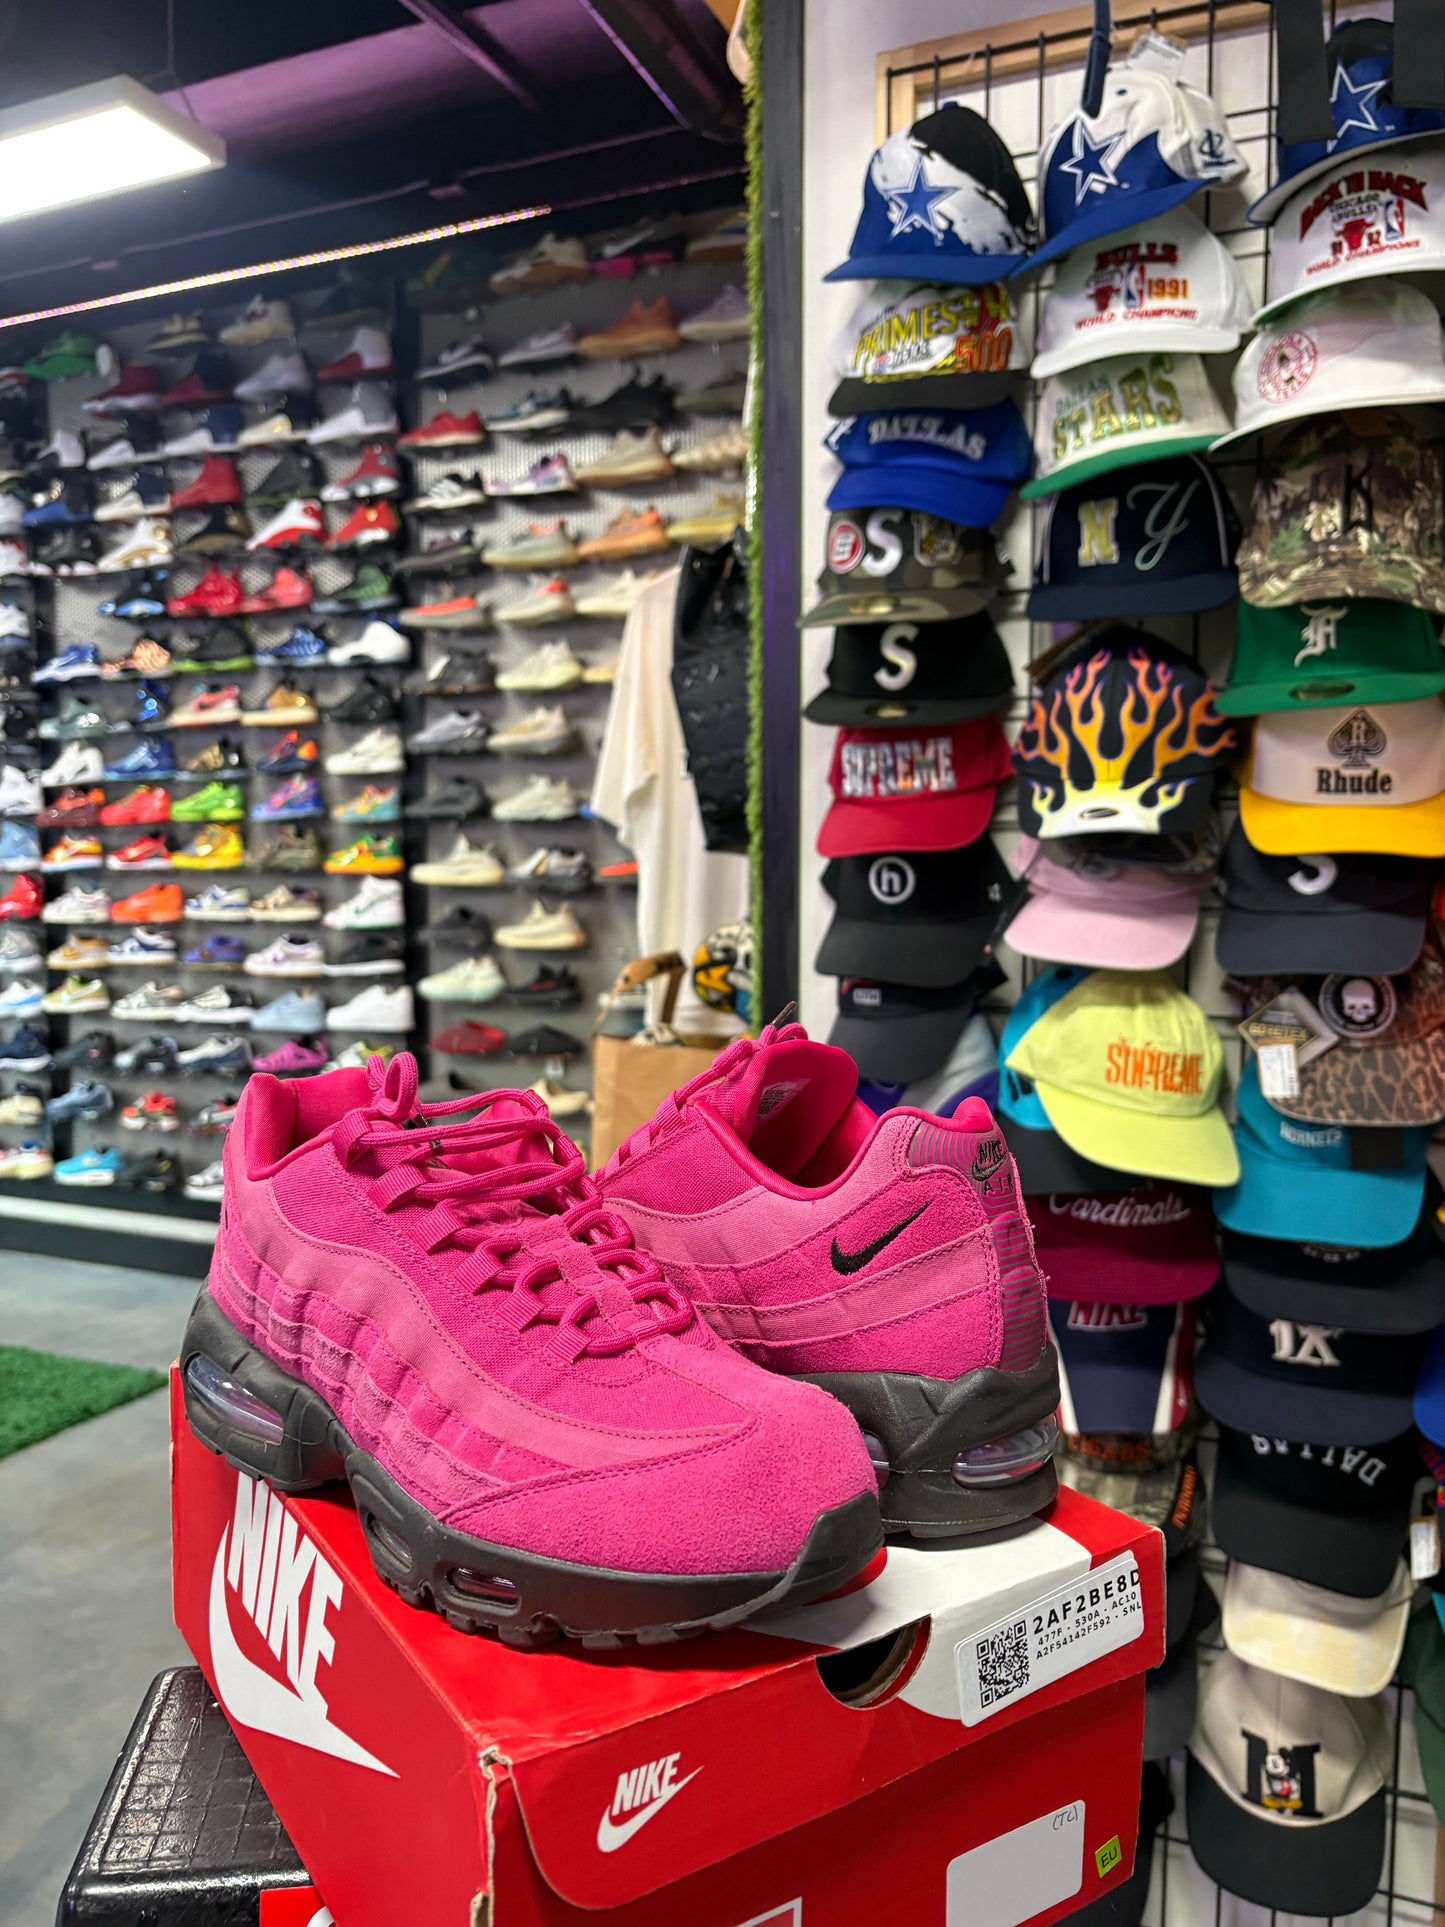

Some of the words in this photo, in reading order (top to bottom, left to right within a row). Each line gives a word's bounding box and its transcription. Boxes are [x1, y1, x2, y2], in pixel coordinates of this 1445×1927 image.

[1096, 243, 1178, 272] BULLS
[1147, 277, 1188, 300] 1991
[954, 326, 1014, 374] 500
[1053, 353, 1182, 459] STARS
[868, 414, 987, 461] DALLAS
[861, 508, 904, 577] S
[873, 622, 920, 693] S
[1316, 767, 1393, 795] Rhude
[978, 1140, 1005, 1165] NIKE
[984, 1173, 1015, 1197] AIR
[1049, 1192, 1192, 1227] Cardinals
[227, 1470, 344, 1722] NIKE
[1033, 1568, 1140, 1636] 2AF2BE8D
[1038, 1627, 1062, 1646] 477F
[1075, 1609, 1100, 1629] 530A
[1112, 1591, 1137, 1610] AC10
[611, 1751, 682, 1817] NIKE
[1101, 1846, 1118, 1869] EU
